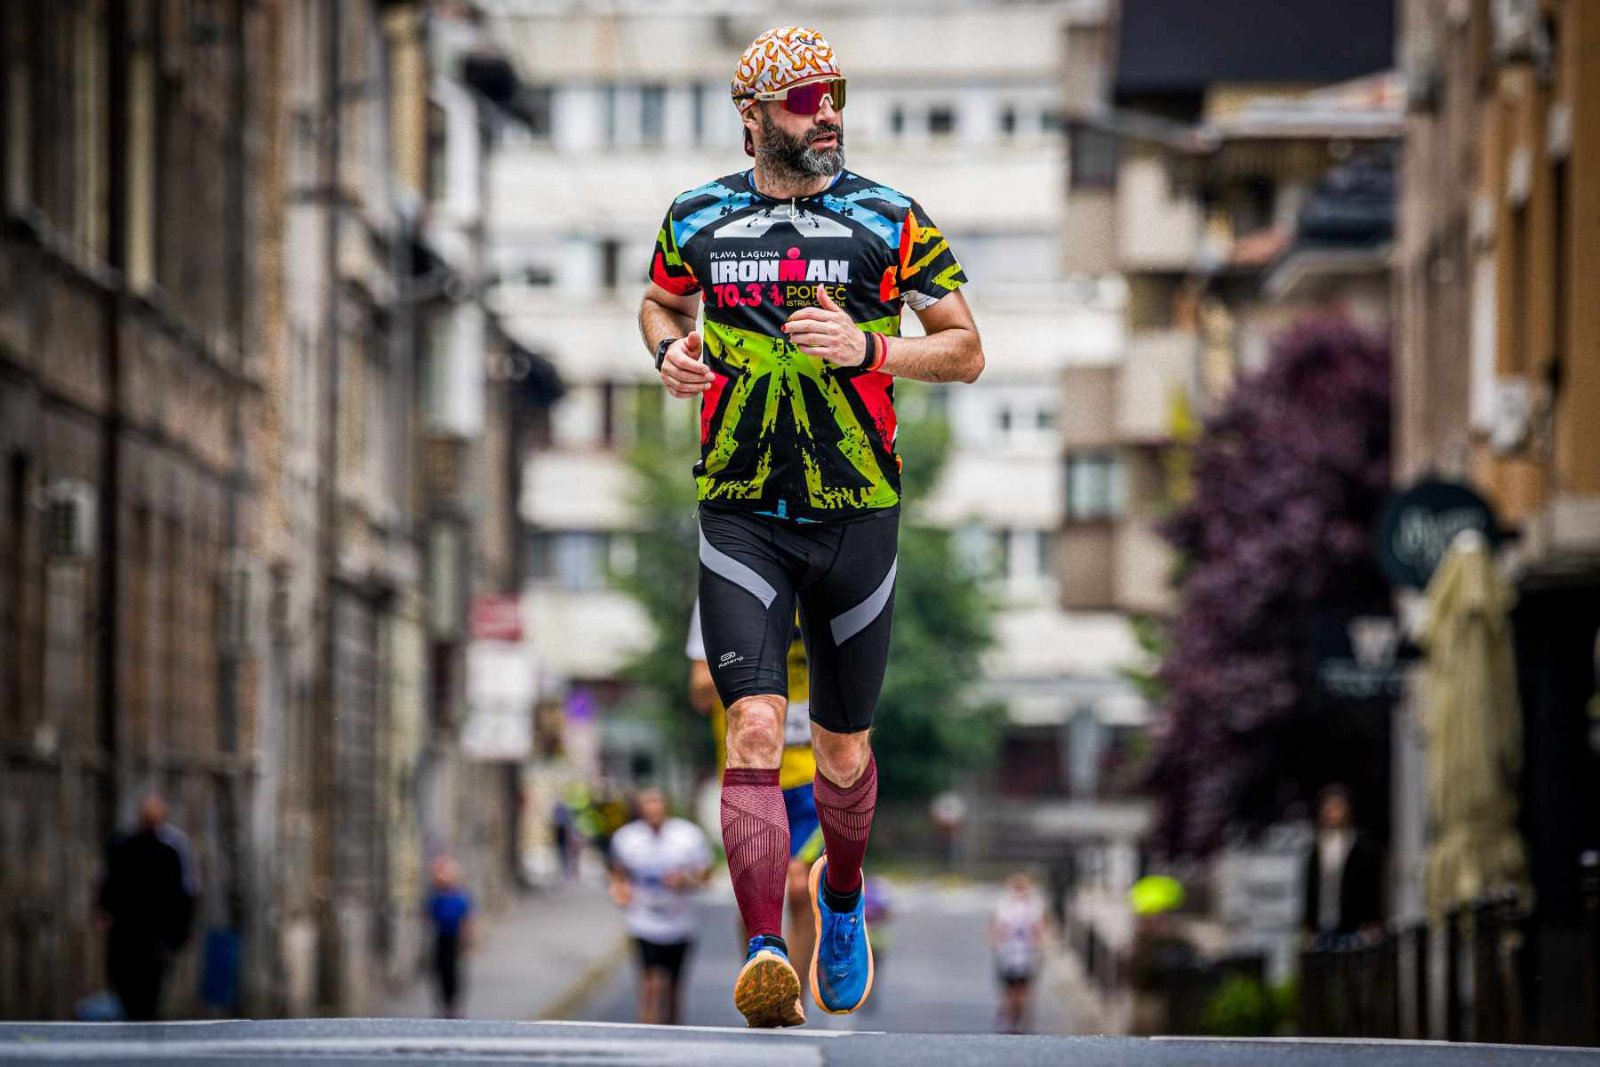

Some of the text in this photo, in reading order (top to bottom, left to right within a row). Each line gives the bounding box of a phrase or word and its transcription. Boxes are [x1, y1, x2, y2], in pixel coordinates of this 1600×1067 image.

[710, 250, 780, 260] PLAVA LAGUNA
[710, 248, 849, 284] IRONMAN
[713, 283, 762, 308] 70.3
